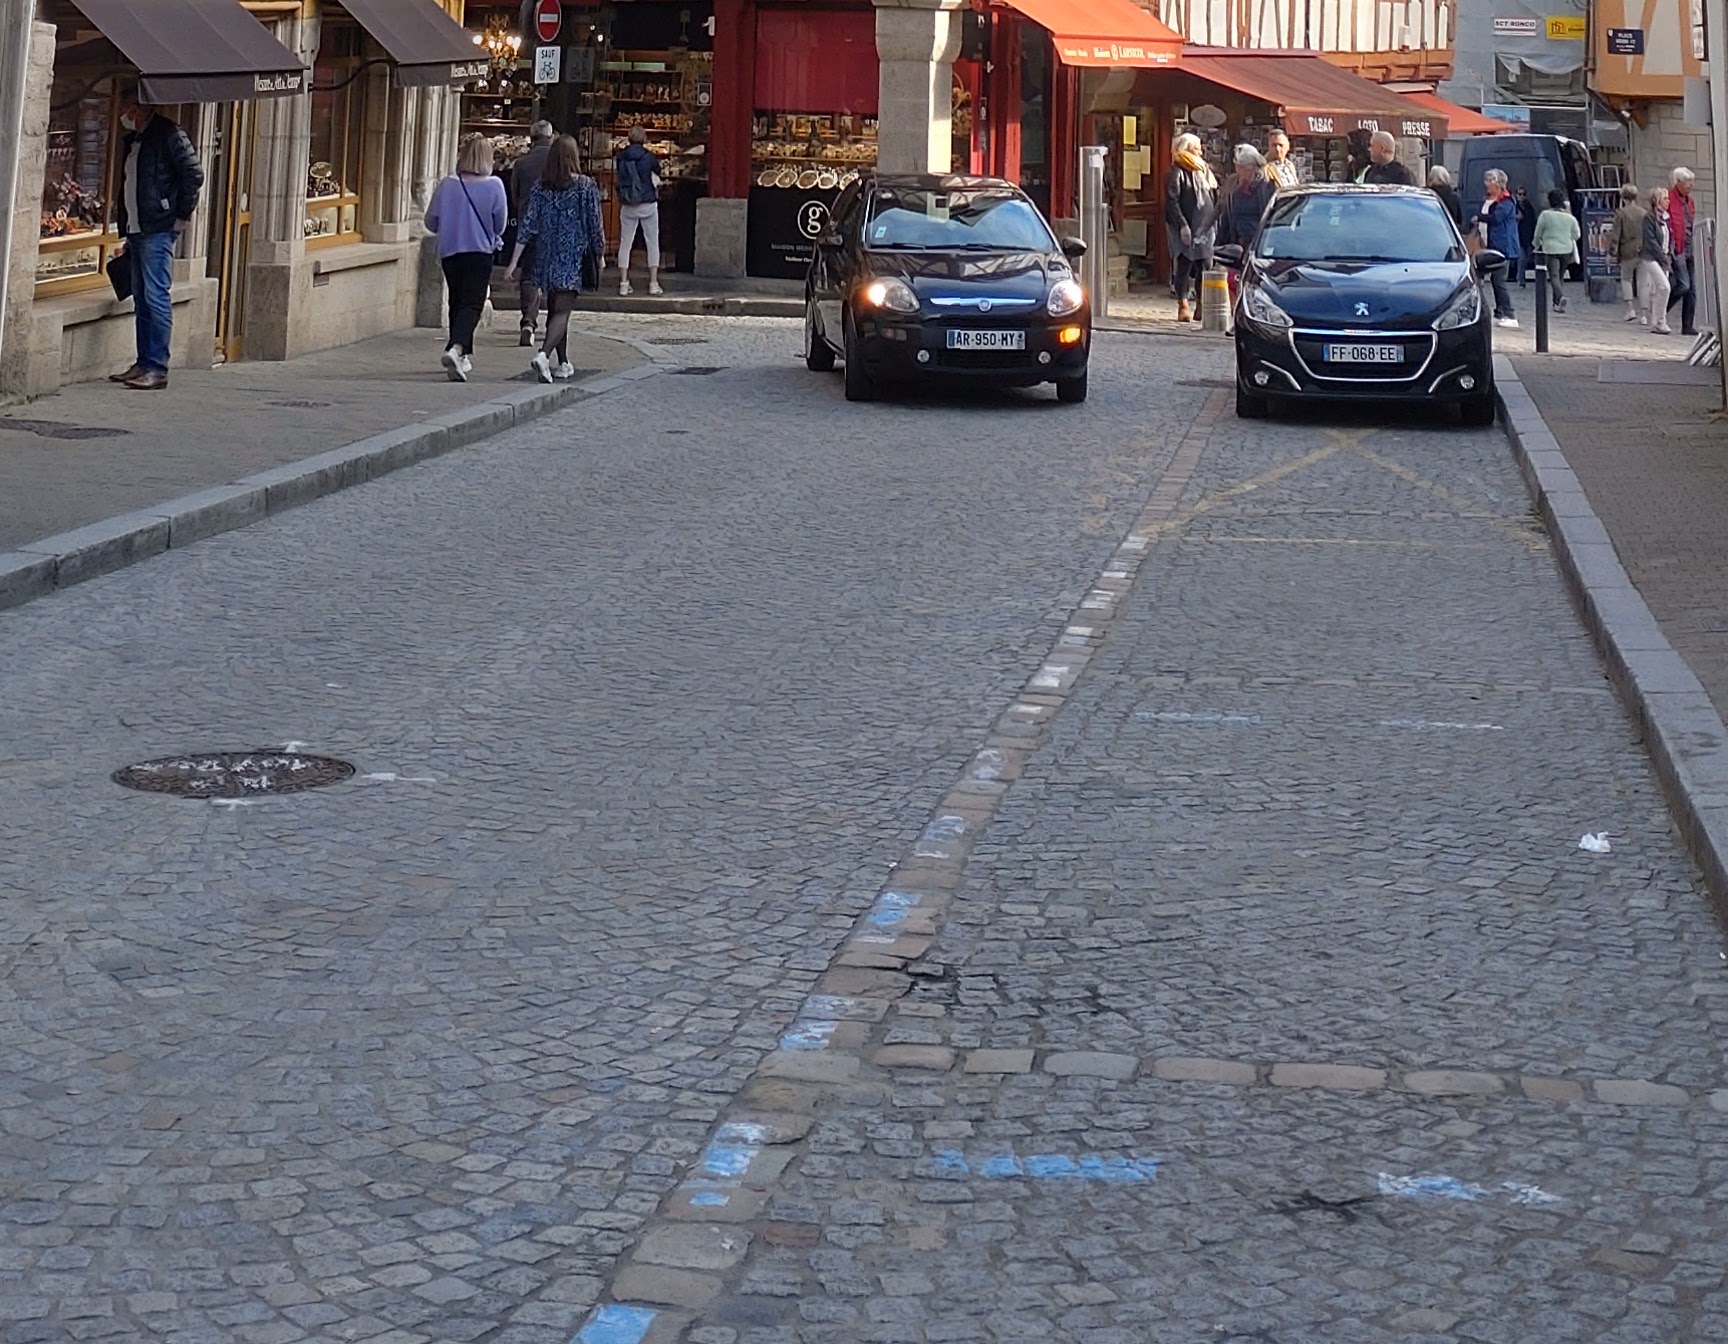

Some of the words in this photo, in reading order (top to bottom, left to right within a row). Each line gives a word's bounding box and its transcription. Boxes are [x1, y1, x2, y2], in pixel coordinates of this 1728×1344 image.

[541, 49, 556, 59] SAUF
[1307, 116, 1335, 133] TABAC
[1358, 119, 1379, 132] LOTO
[1402, 121, 1431, 137] PRESSE
[1331, 346, 1396, 361] FF-068-EE
